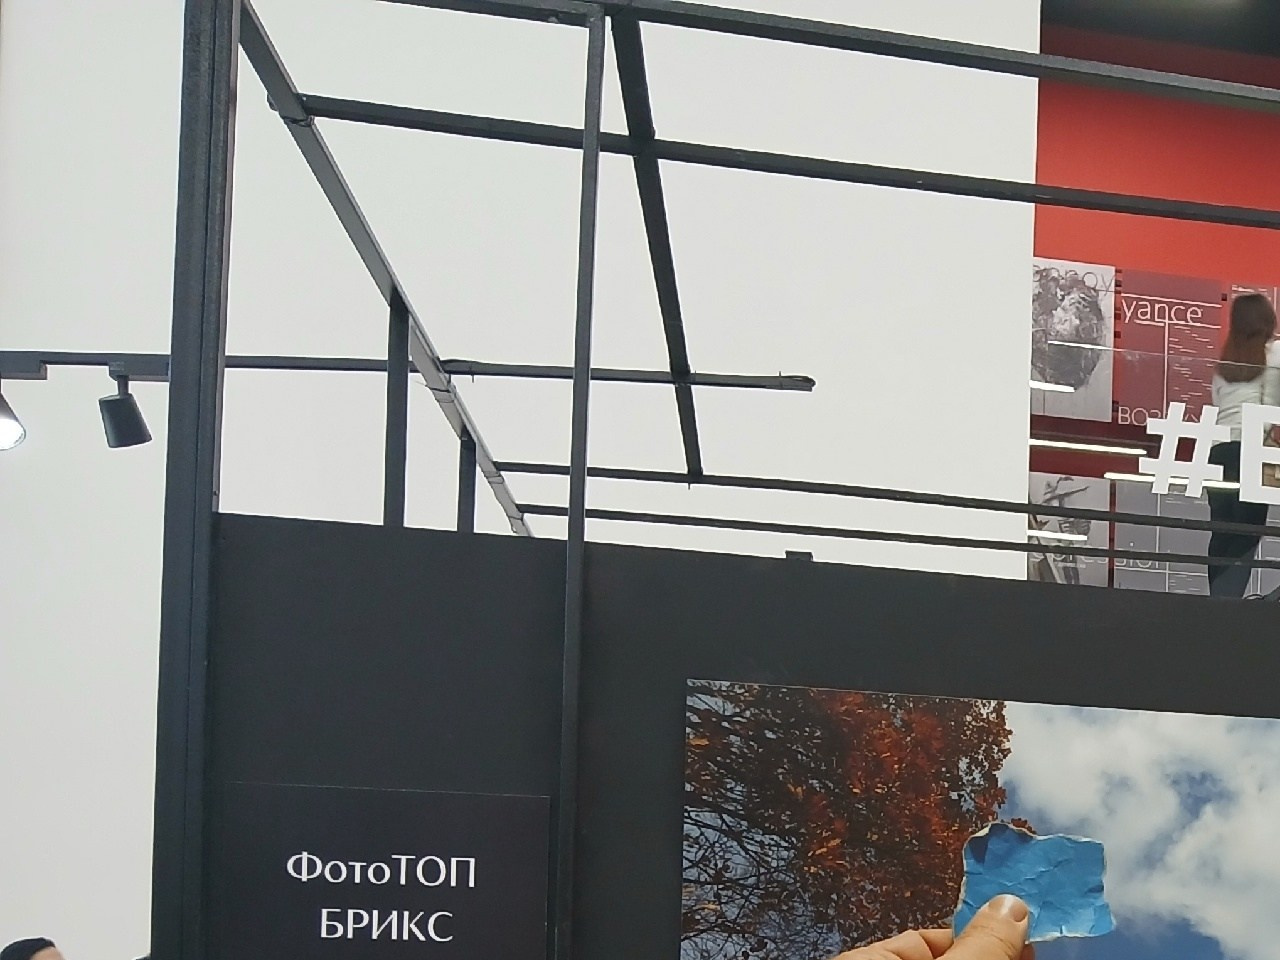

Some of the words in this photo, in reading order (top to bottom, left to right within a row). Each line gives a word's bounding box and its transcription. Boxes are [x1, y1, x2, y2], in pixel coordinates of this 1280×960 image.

[1121, 297, 1204, 326] yance
[286, 850, 477, 888] ФотоТОП
[320, 908, 454, 942] БРИКС
